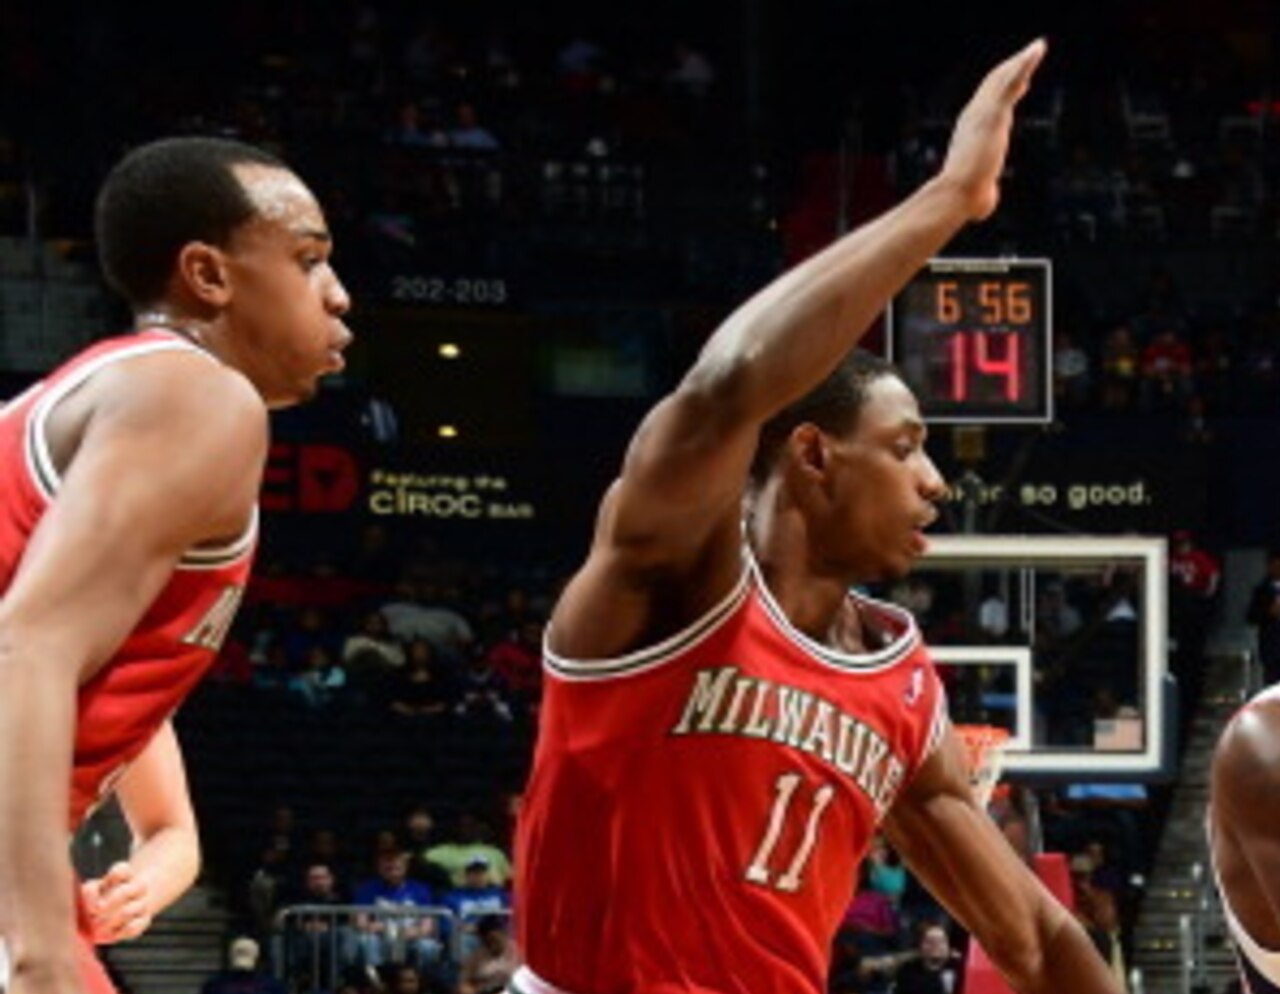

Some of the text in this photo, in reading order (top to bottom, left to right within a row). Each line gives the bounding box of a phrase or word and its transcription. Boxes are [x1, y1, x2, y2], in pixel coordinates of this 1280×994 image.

[392, 276, 507, 302] 202-203
[952, 331, 1019, 402] 14
[1020, 486, 1058, 505] so
[744, 772, 836, 892] 11
